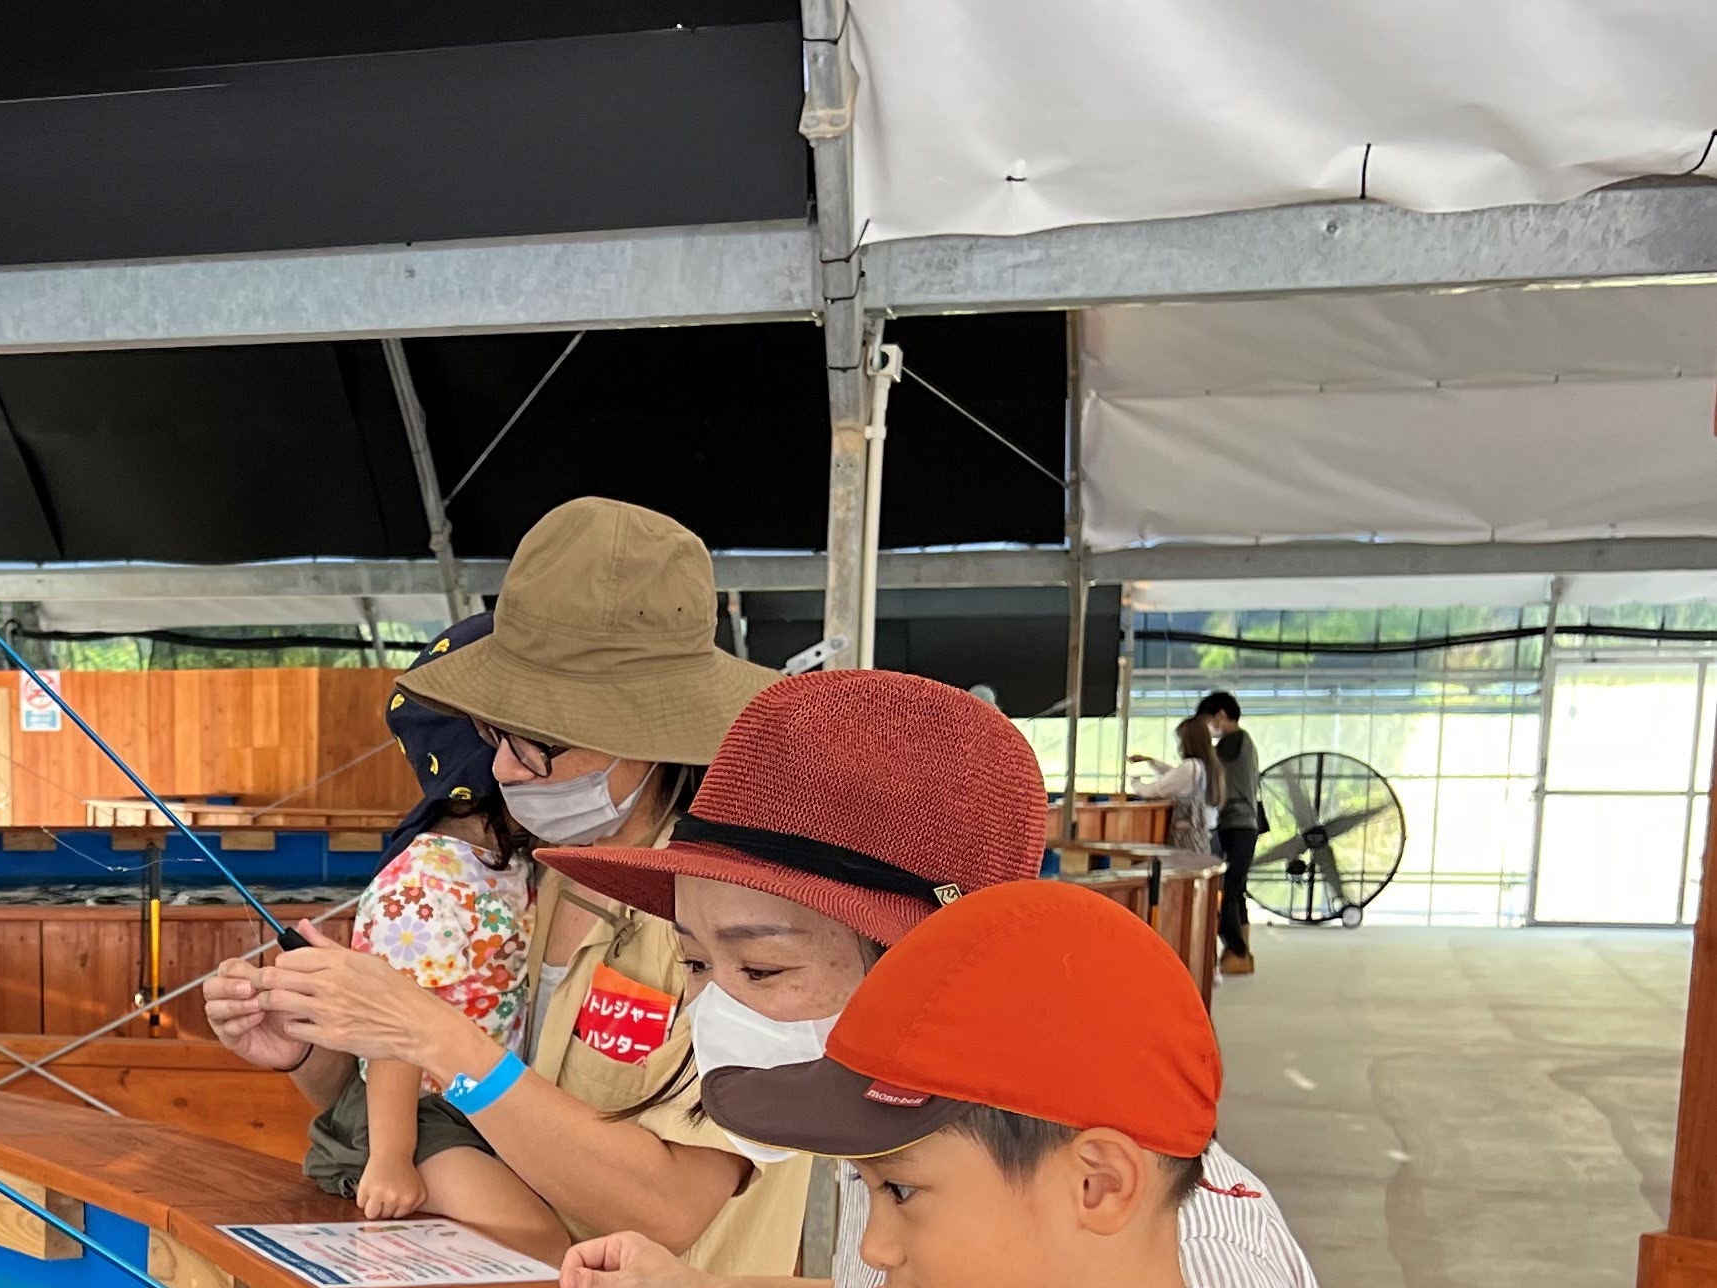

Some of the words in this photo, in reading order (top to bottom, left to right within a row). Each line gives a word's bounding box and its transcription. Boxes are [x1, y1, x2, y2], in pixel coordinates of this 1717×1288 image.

[589, 995, 664, 1023] トレジャー
[586, 1029, 651, 1054] ハンター
